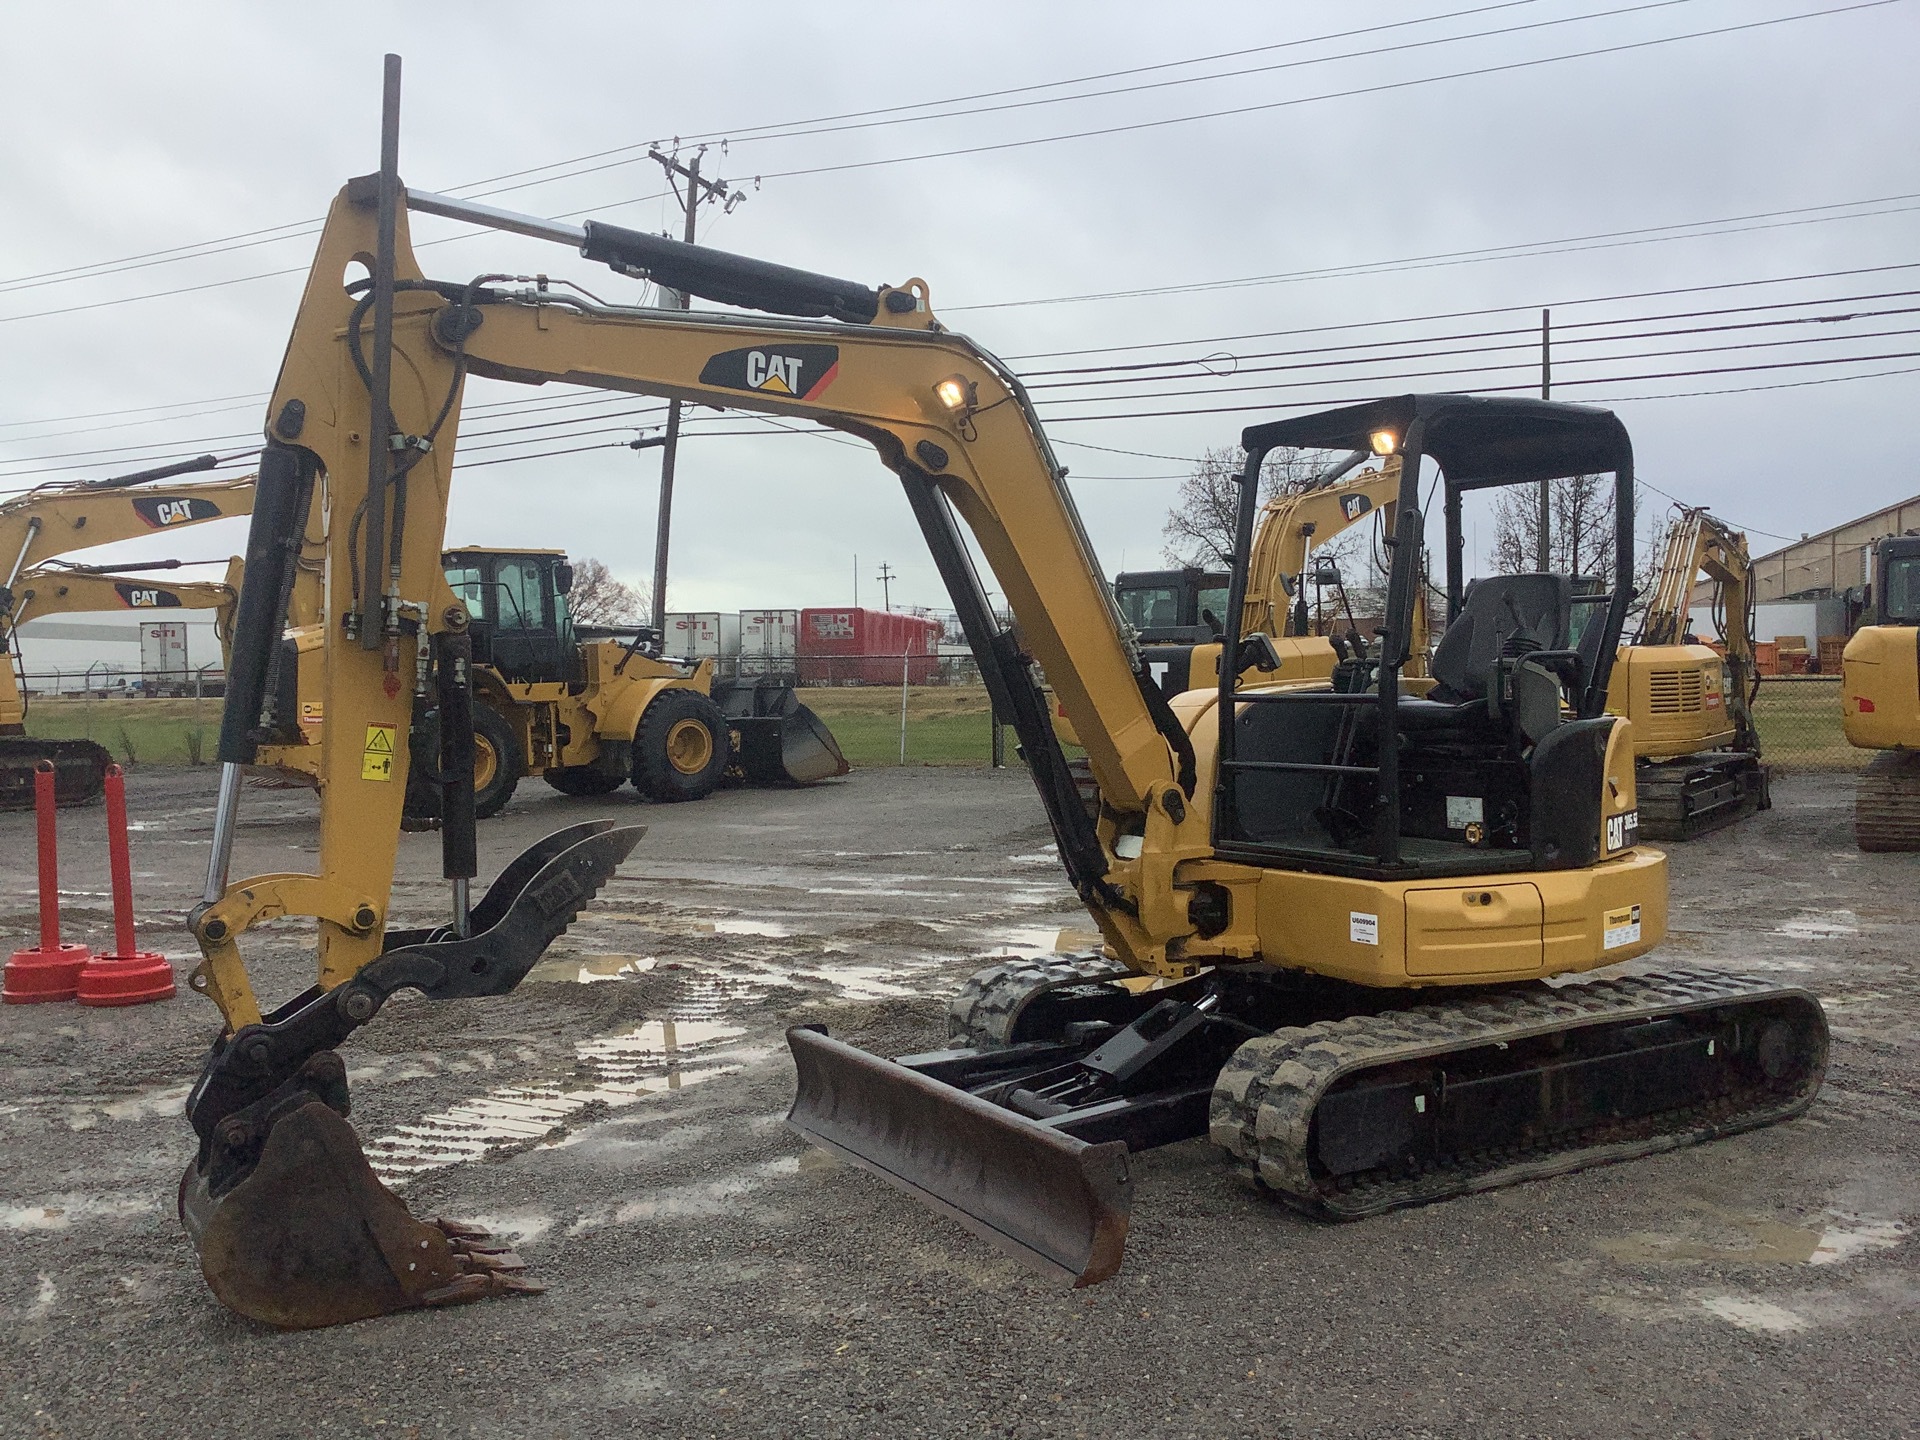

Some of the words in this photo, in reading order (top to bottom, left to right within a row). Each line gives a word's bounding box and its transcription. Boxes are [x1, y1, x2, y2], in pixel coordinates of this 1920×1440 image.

[746, 351, 803, 394] CAT
[157, 500, 192, 525] CAT
[1346, 496, 1361, 520] CAT
[131, 590, 159, 606] CAT
[676, 621, 707, 630] STI
[753, 616, 783, 624] STI
[151, 630, 176, 638] STI
[1607, 816, 1624, 851] CAT
